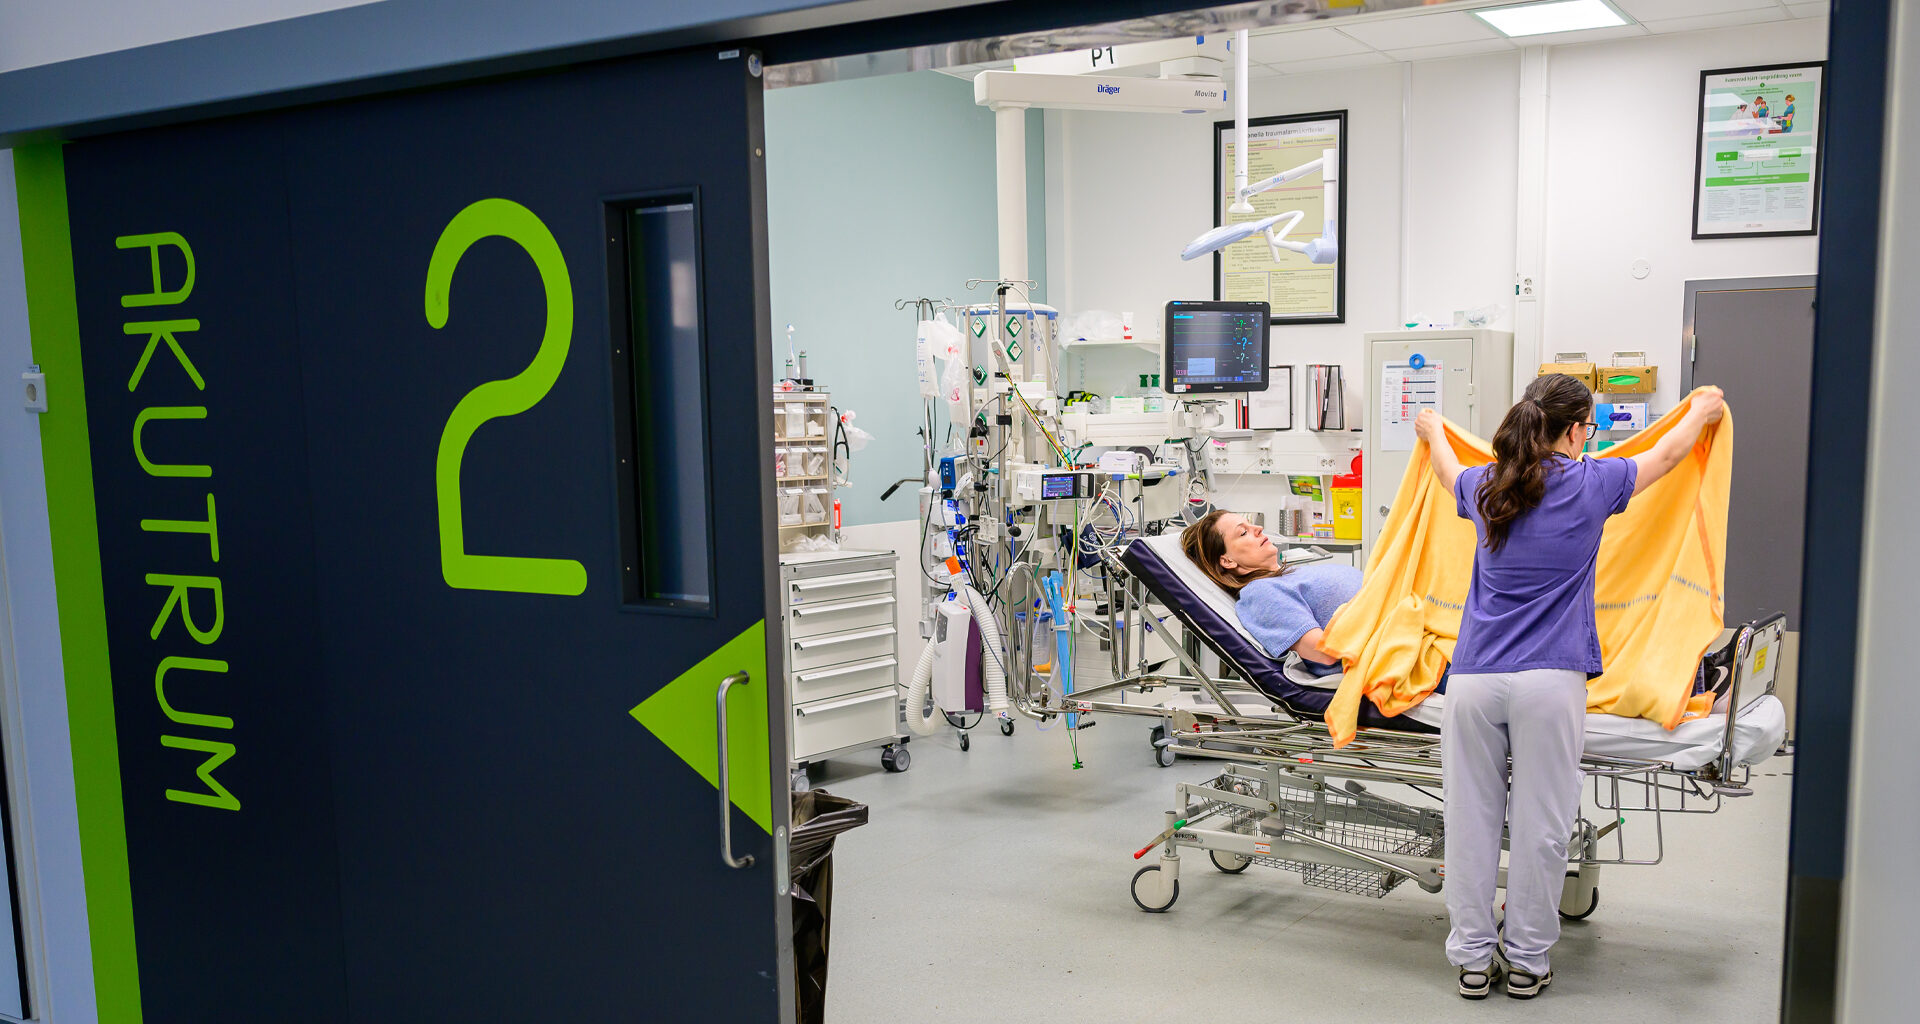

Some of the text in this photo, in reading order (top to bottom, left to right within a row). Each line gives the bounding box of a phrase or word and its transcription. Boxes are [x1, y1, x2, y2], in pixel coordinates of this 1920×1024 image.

[1091, 46, 1114, 67] P1
[1097, 83, 1121, 95] Dräger
[1194, 90, 1217, 98] Movita
[425, 198, 588, 596] 2
[116, 231, 241, 812] AKUTRUM
